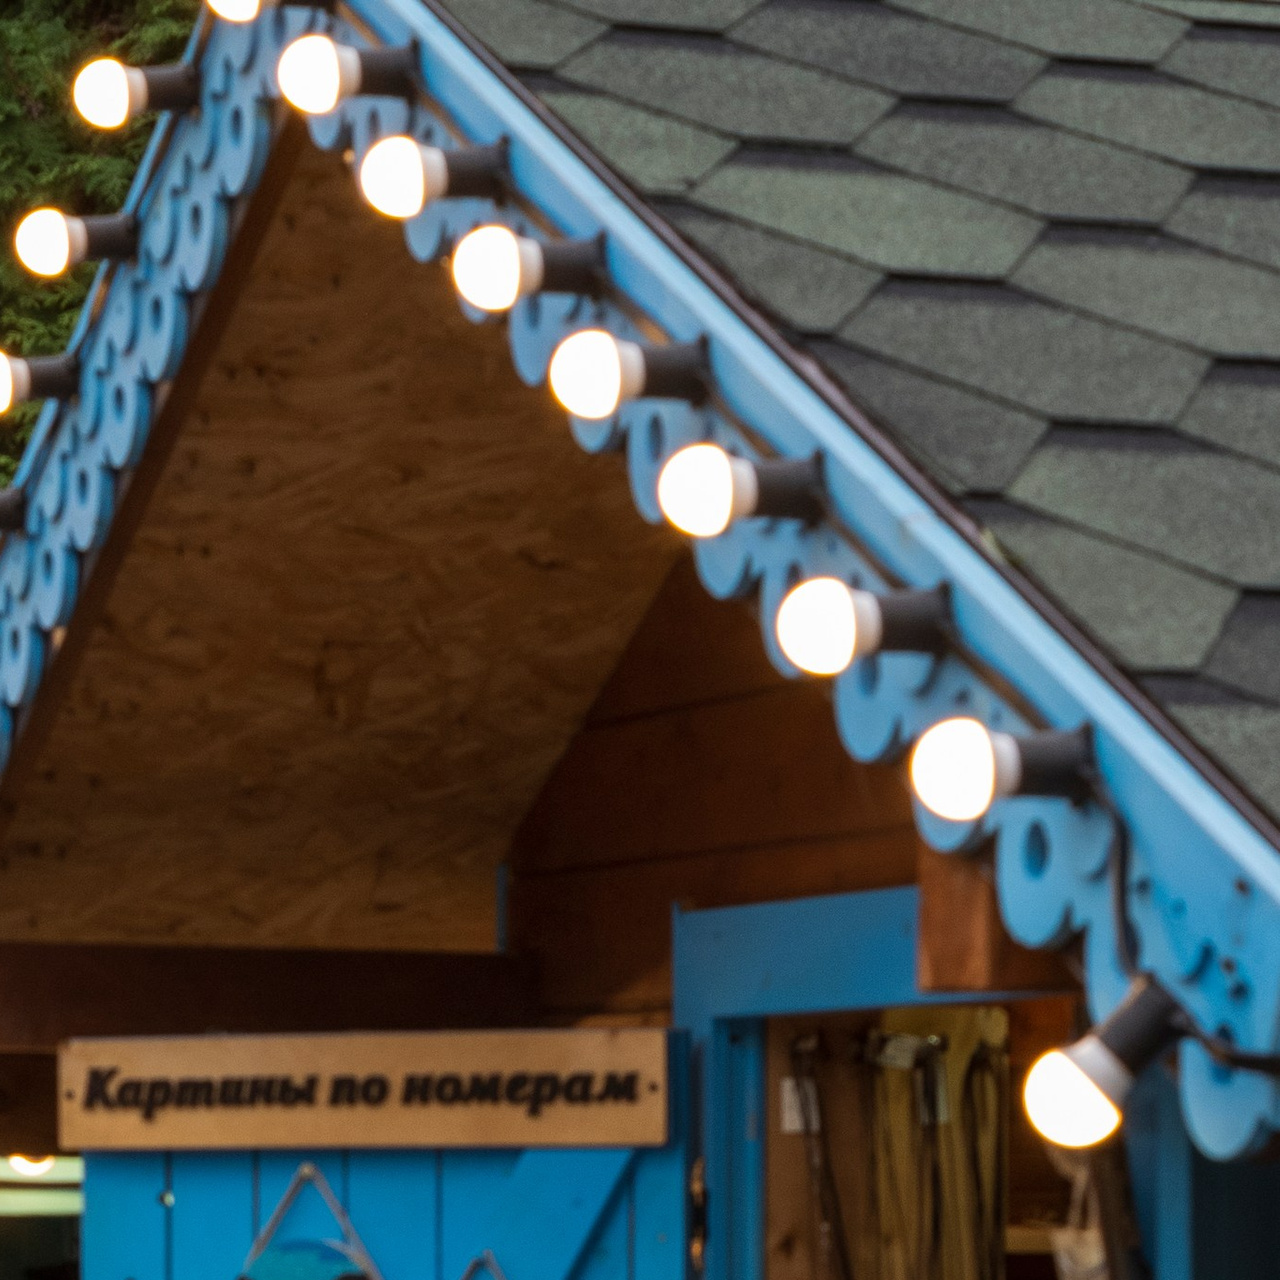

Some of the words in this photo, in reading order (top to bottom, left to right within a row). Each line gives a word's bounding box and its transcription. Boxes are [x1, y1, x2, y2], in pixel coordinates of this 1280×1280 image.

[83, 1066, 320, 1123] Картины
[327, 1073, 391, 1108] по
[400, 1070, 640, 1118] номерам
